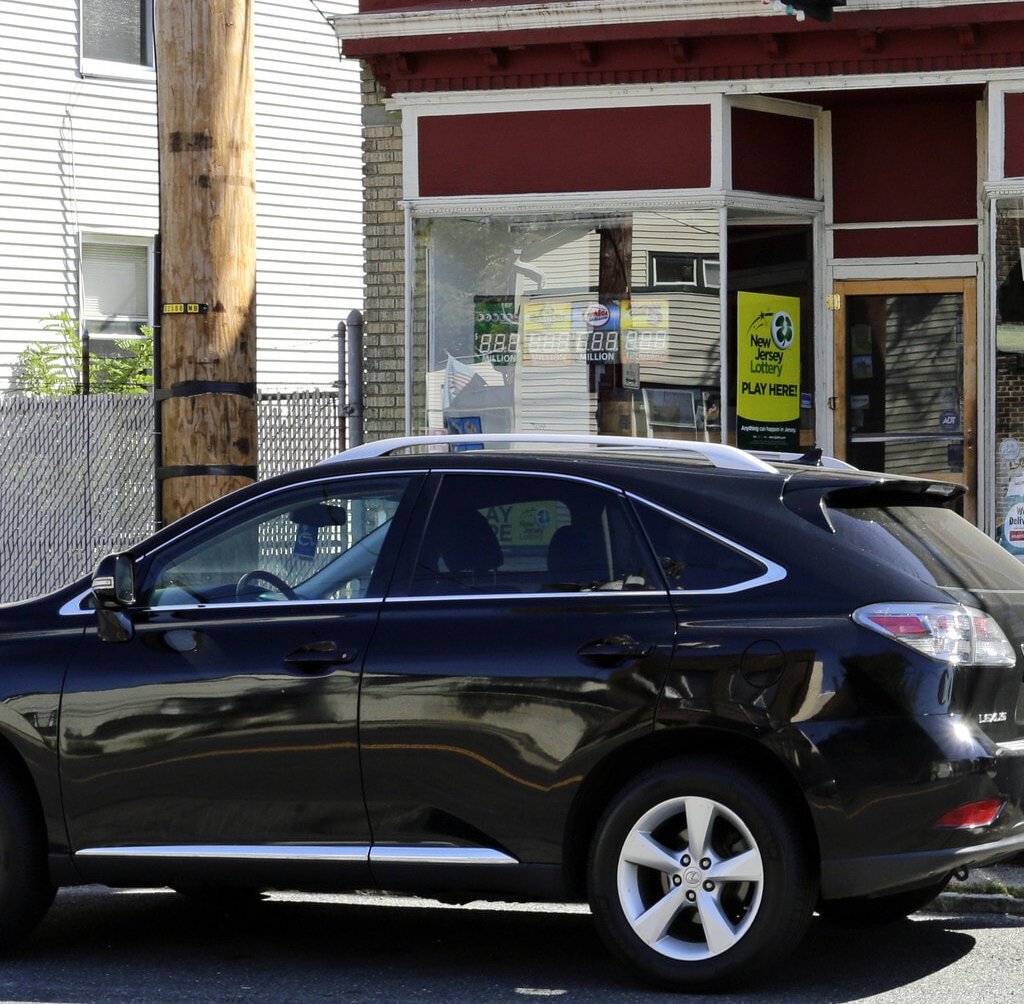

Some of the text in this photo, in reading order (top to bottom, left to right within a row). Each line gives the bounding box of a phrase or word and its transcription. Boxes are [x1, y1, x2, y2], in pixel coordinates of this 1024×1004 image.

[750, 334, 771, 348] New
[579, 352, 615, 361] MILLION
[754, 348, 784, 365] Jersey
[750, 360, 783, 377] Lottery
[741, 382, 798, 397] PLAY HERE!
[942, 416, 956, 425] ADT
[978, 711, 1008, 724] LEXUS
